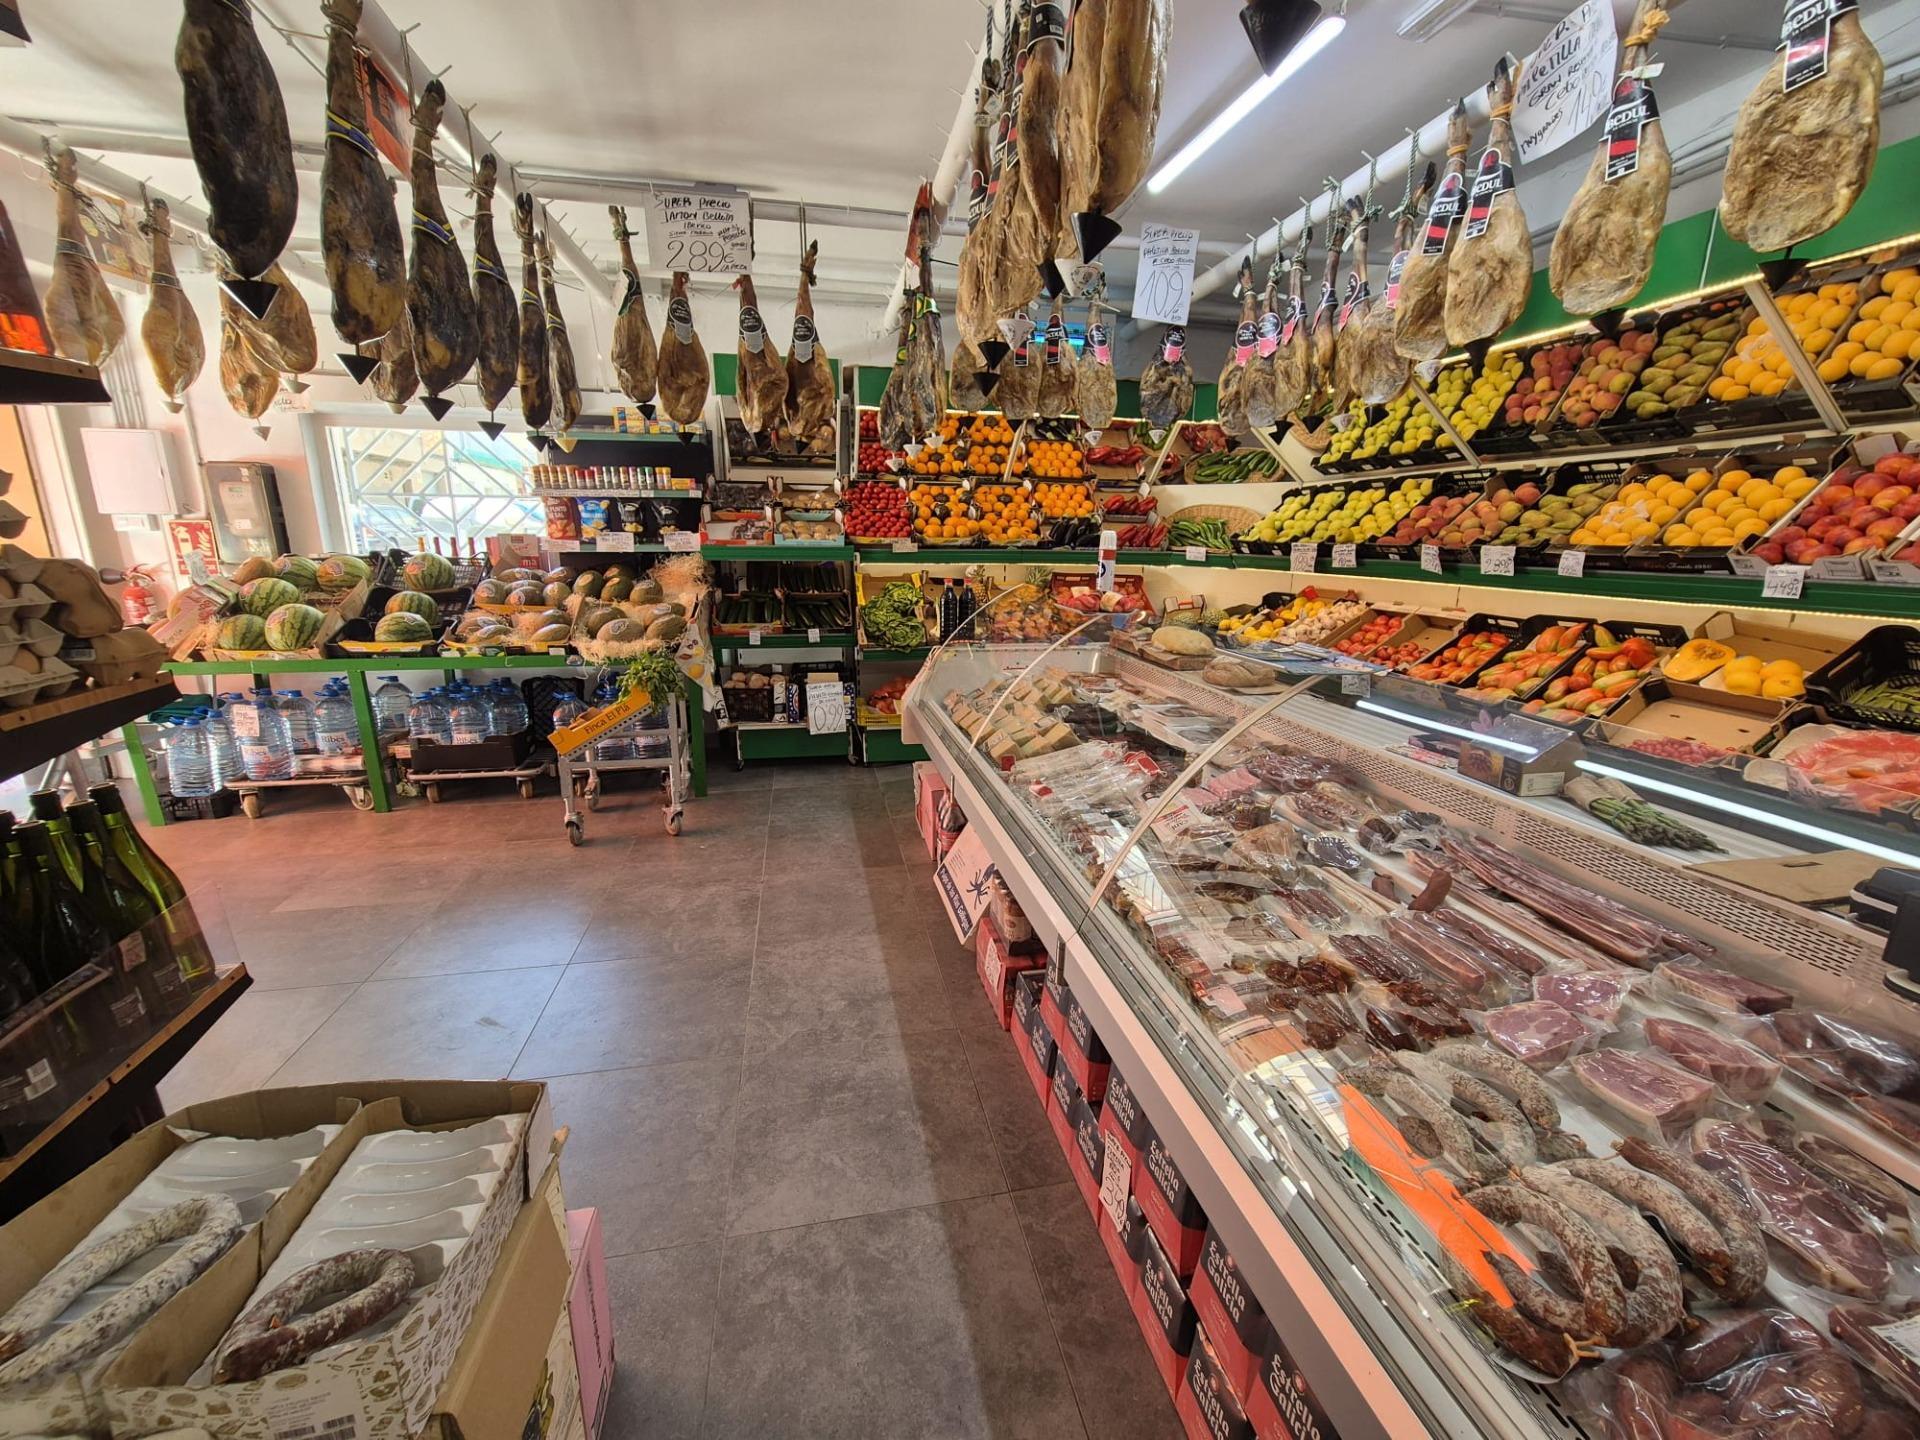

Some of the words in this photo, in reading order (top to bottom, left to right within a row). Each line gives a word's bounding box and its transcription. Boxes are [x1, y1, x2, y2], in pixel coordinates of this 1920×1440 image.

[1140, 270, 1184, 318] 109
[584, 718, 607, 735] Finca
[1109, 1091, 1131, 1132] Galicia
[1111, 1077, 1135, 1121] Estrella
[1148, 1154, 1175, 1204] Galicia
[1150, 1139, 1179, 1192] Estrella
[1144, 1272, 1169, 1330] Galicia
[1145, 1258, 1173, 1319] Estrella
[1207, 1256, 1240, 1324] Galicia
[1208, 1240, 1246, 1312] Estrella
[1193, 1358, 1230, 1438] Estrella
[1270, 1372, 1307, 1440] Galici
[1271, 1353, 1321, 1440] Estrella
